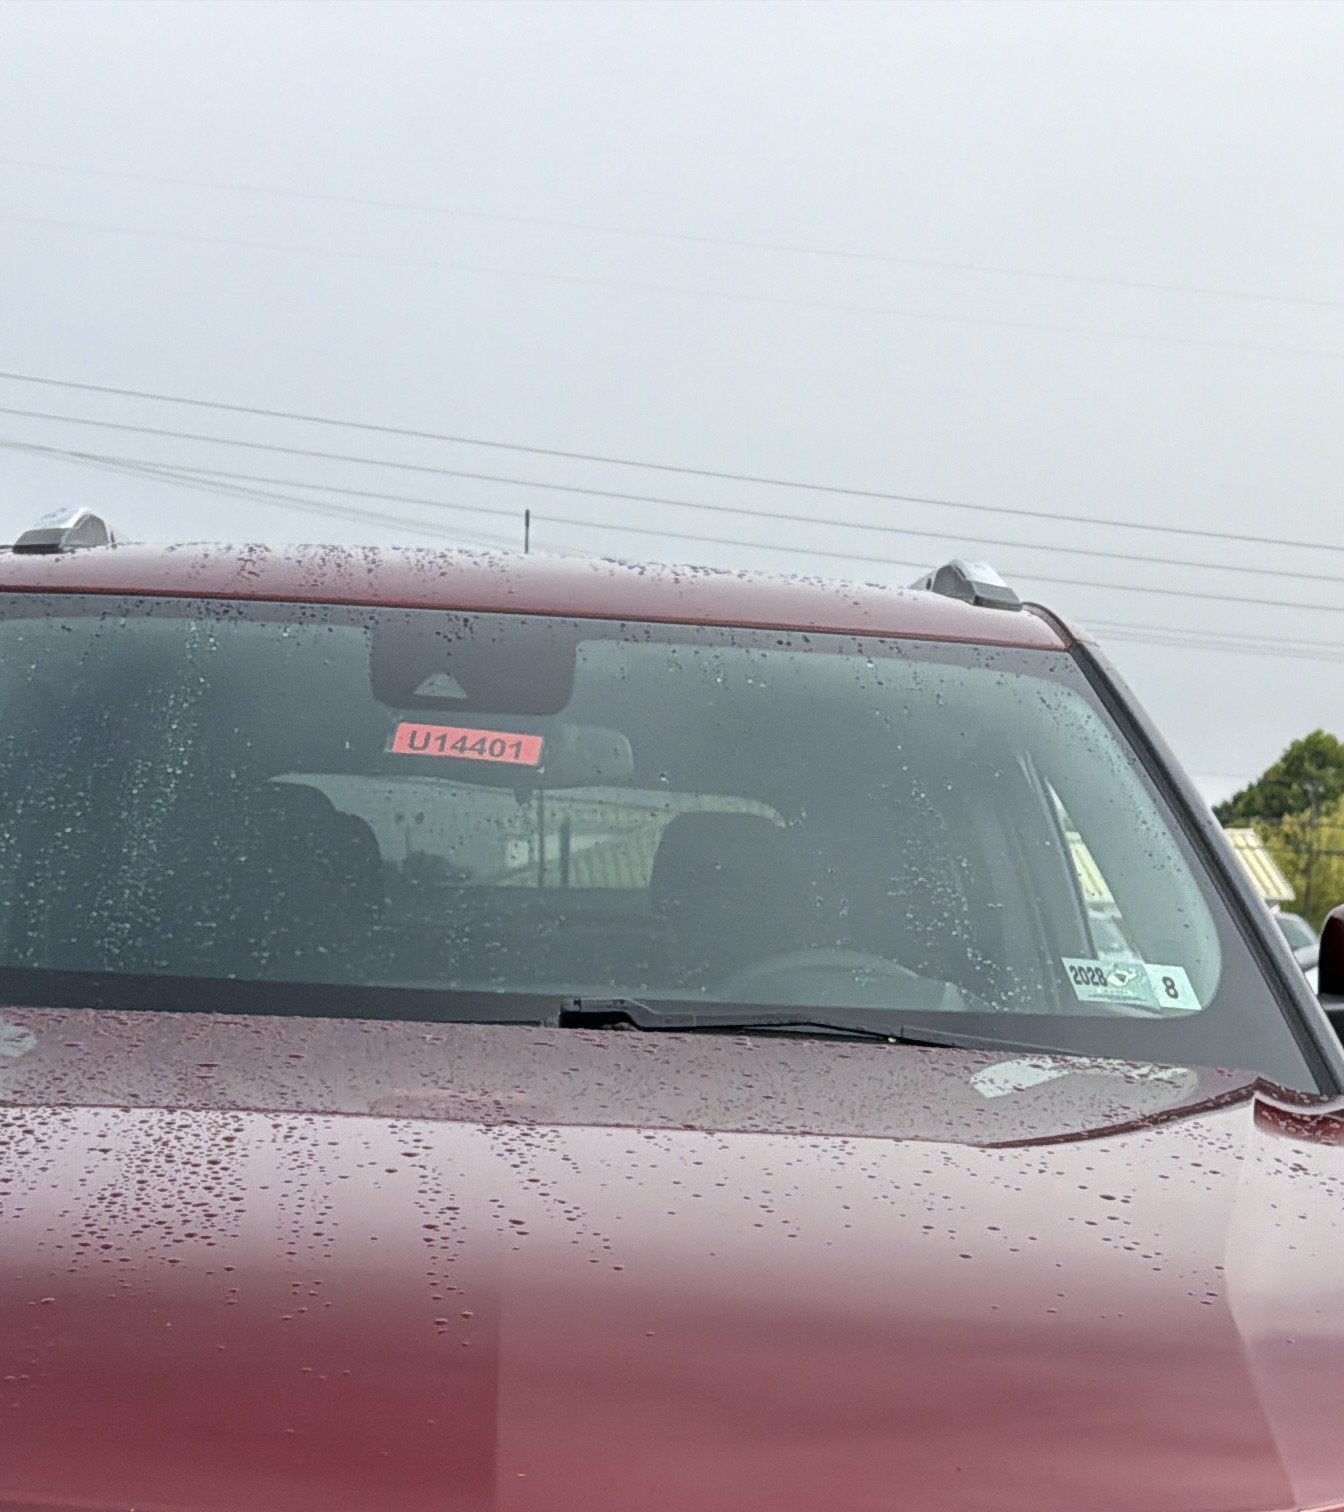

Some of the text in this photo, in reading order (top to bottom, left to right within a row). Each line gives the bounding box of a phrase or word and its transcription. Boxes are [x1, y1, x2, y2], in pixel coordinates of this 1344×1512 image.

[408, 730, 523, 760] U14401
[1069, 965, 1108, 987] 2028
[1161, 975, 1179, 1000] 8
